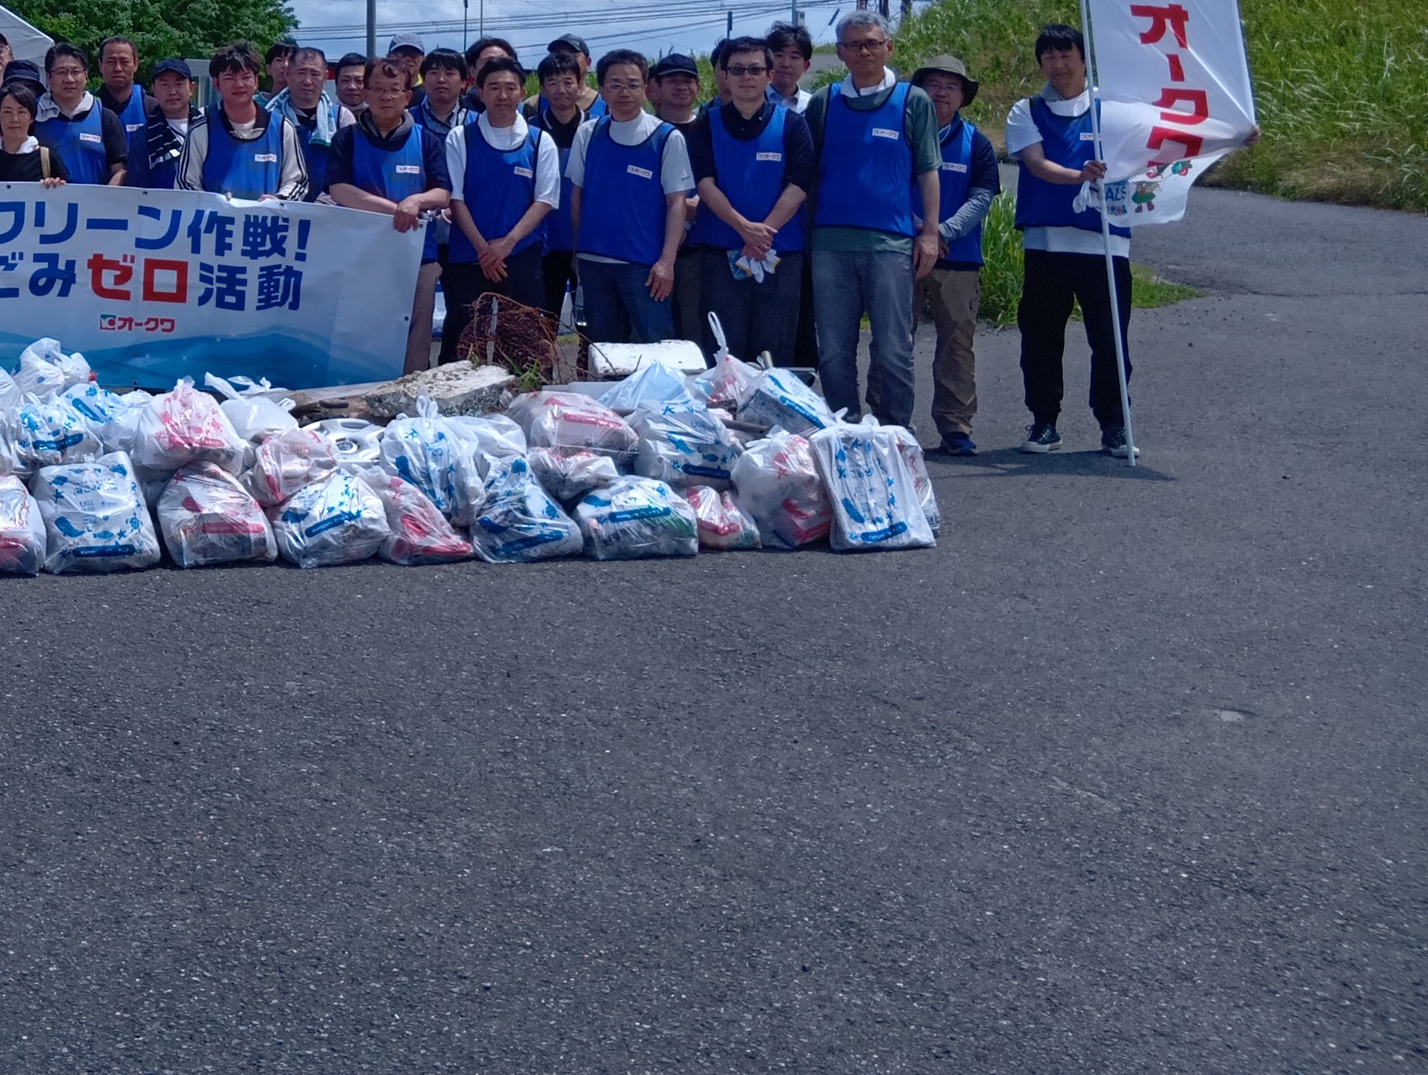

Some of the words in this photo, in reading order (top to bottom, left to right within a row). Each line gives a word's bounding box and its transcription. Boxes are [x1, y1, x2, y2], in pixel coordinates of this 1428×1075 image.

[1129, 3, 1210, 168] オークワ
[117, 316, 176, 333] オークワ
